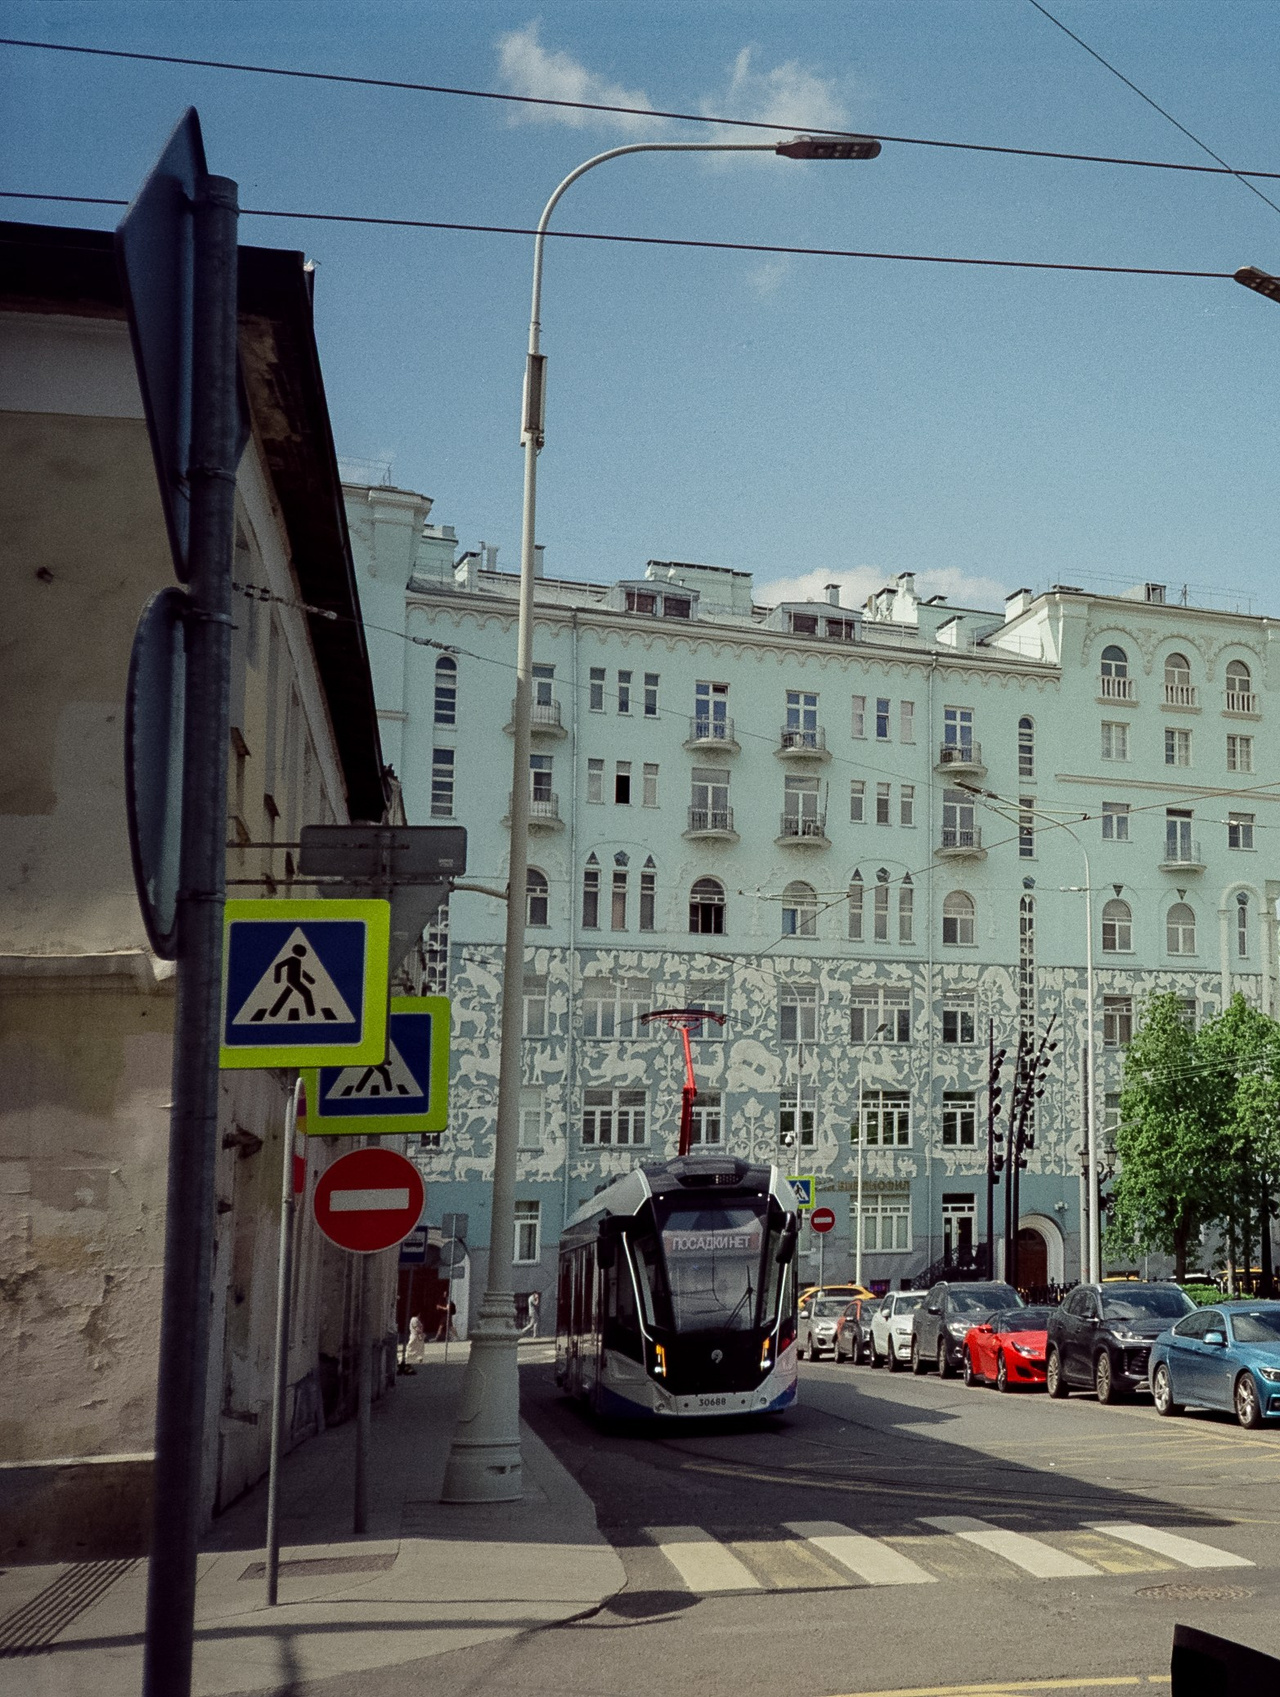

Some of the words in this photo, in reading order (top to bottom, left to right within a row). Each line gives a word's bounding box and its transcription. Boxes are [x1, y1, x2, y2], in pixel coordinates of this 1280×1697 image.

[672, 1236, 728, 1251] ПОСАДКИ
[729, 1235, 751, 1249] НЕТ
[698, 1398, 726, 1406] 30688
